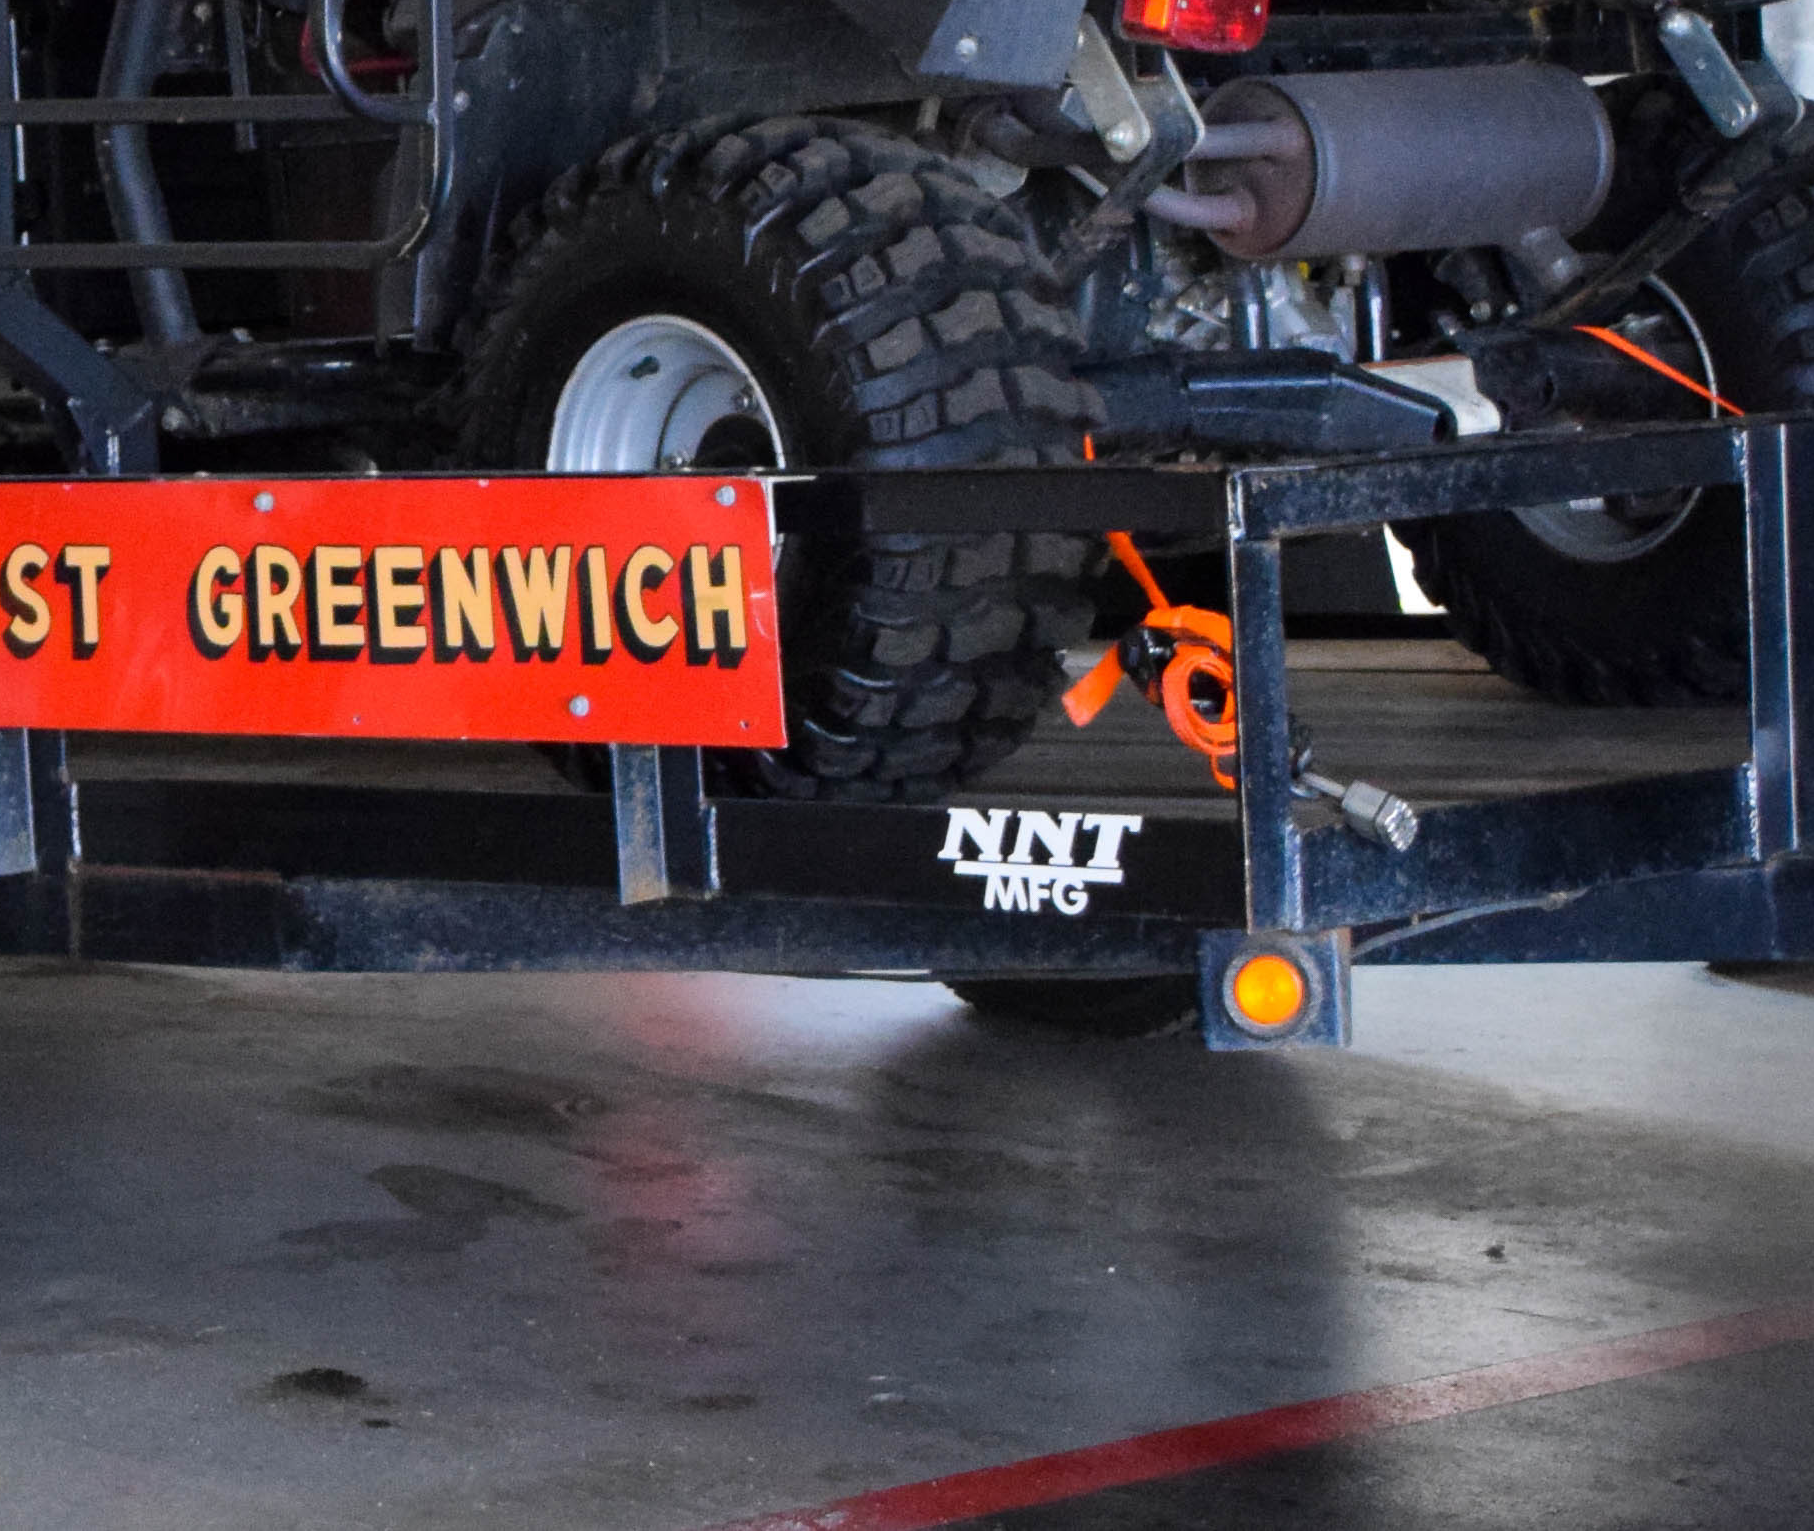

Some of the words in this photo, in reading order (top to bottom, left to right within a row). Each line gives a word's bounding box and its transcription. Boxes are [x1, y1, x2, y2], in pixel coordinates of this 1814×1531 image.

[187, 543, 747, 668] GREENWICH
[937, 807, 1144, 869] NNT
[984, 872, 1089, 916] MFG
